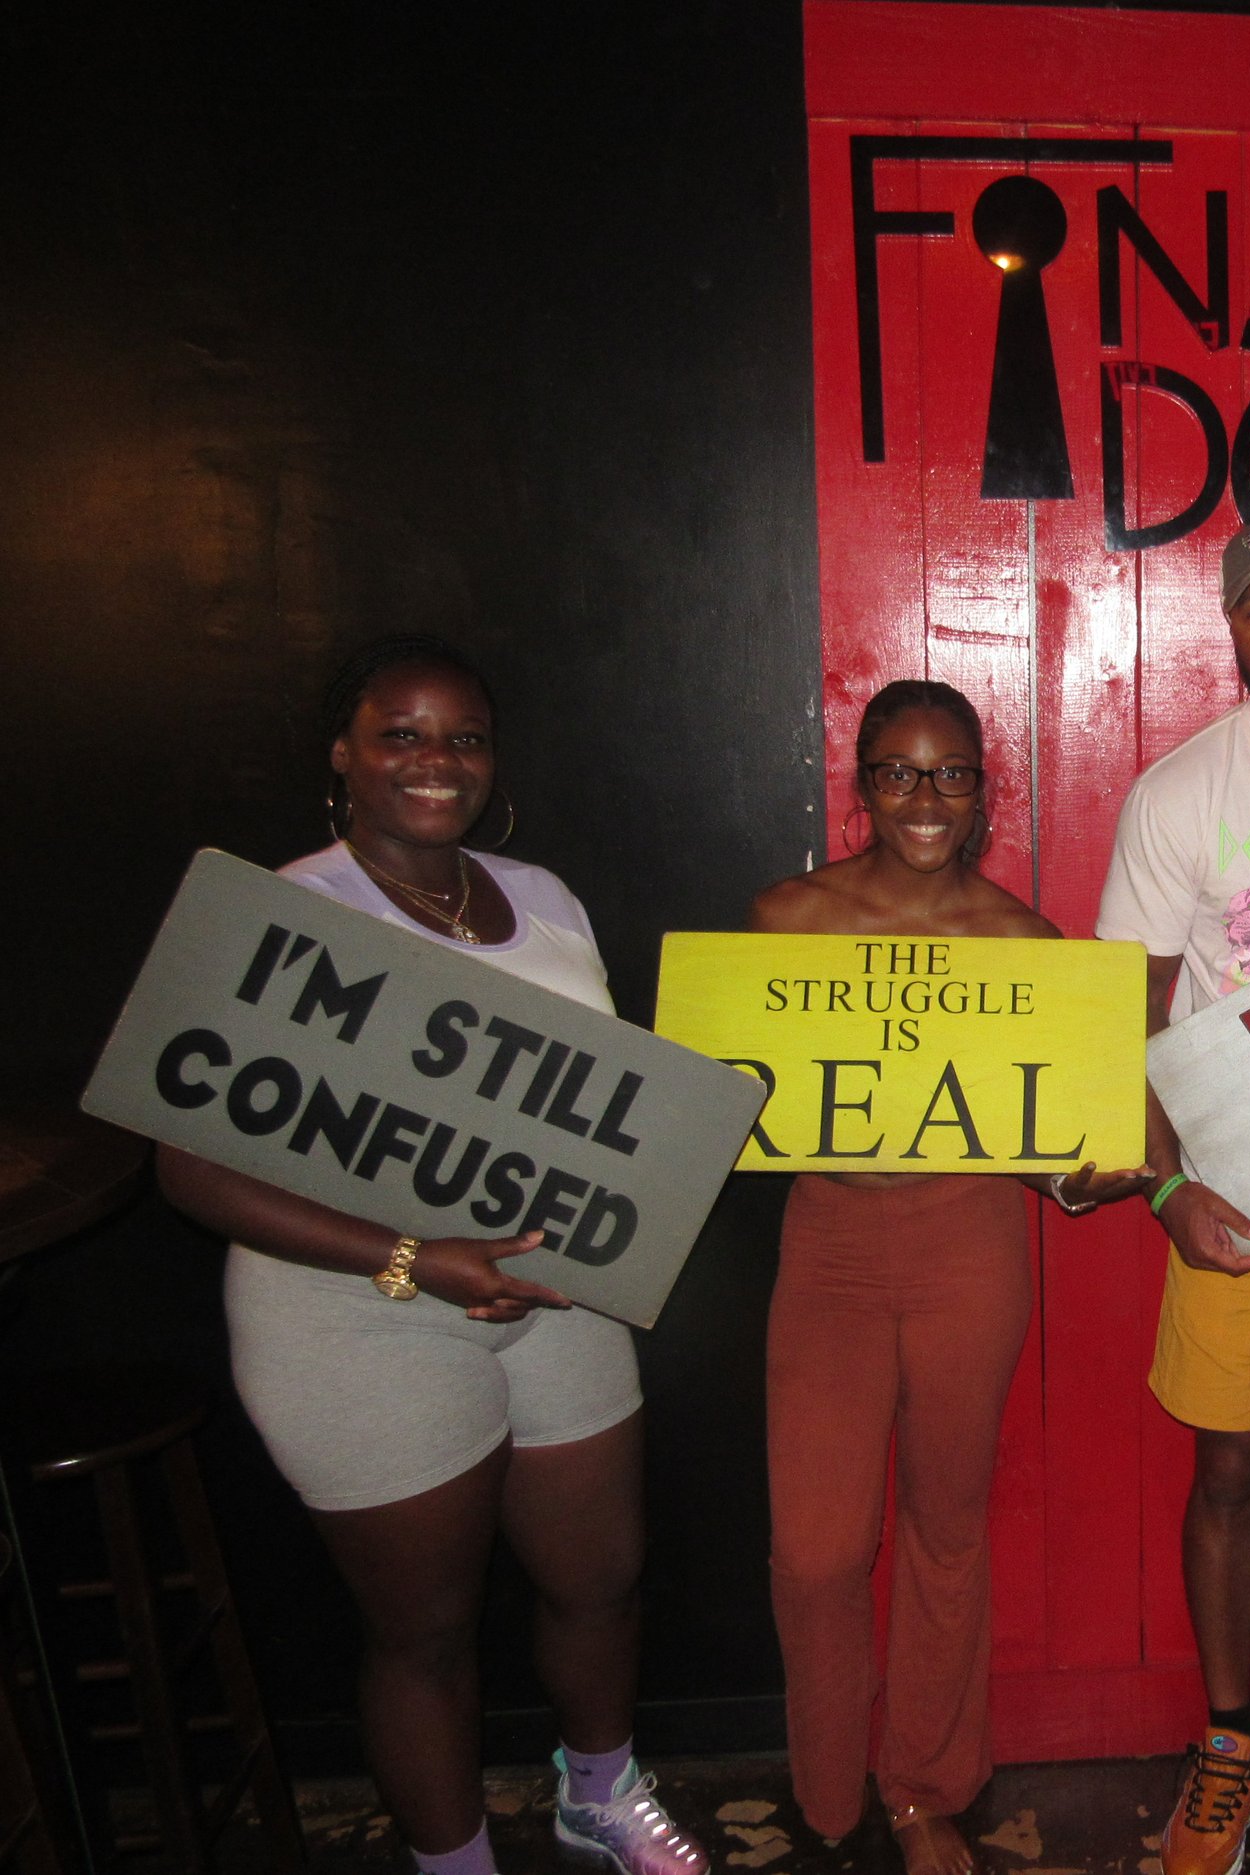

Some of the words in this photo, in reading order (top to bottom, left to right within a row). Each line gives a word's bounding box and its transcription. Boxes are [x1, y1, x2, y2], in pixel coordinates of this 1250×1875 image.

[856, 943, 951, 975] THE
[765, 979, 1035, 1015] STRUGGLE
[236, 923, 389, 1044] I'M
[411, 1000, 644, 1156] STILL
[880, 1019, 920, 1052] IS
[155, 1028, 638, 1267] CONFUSED
